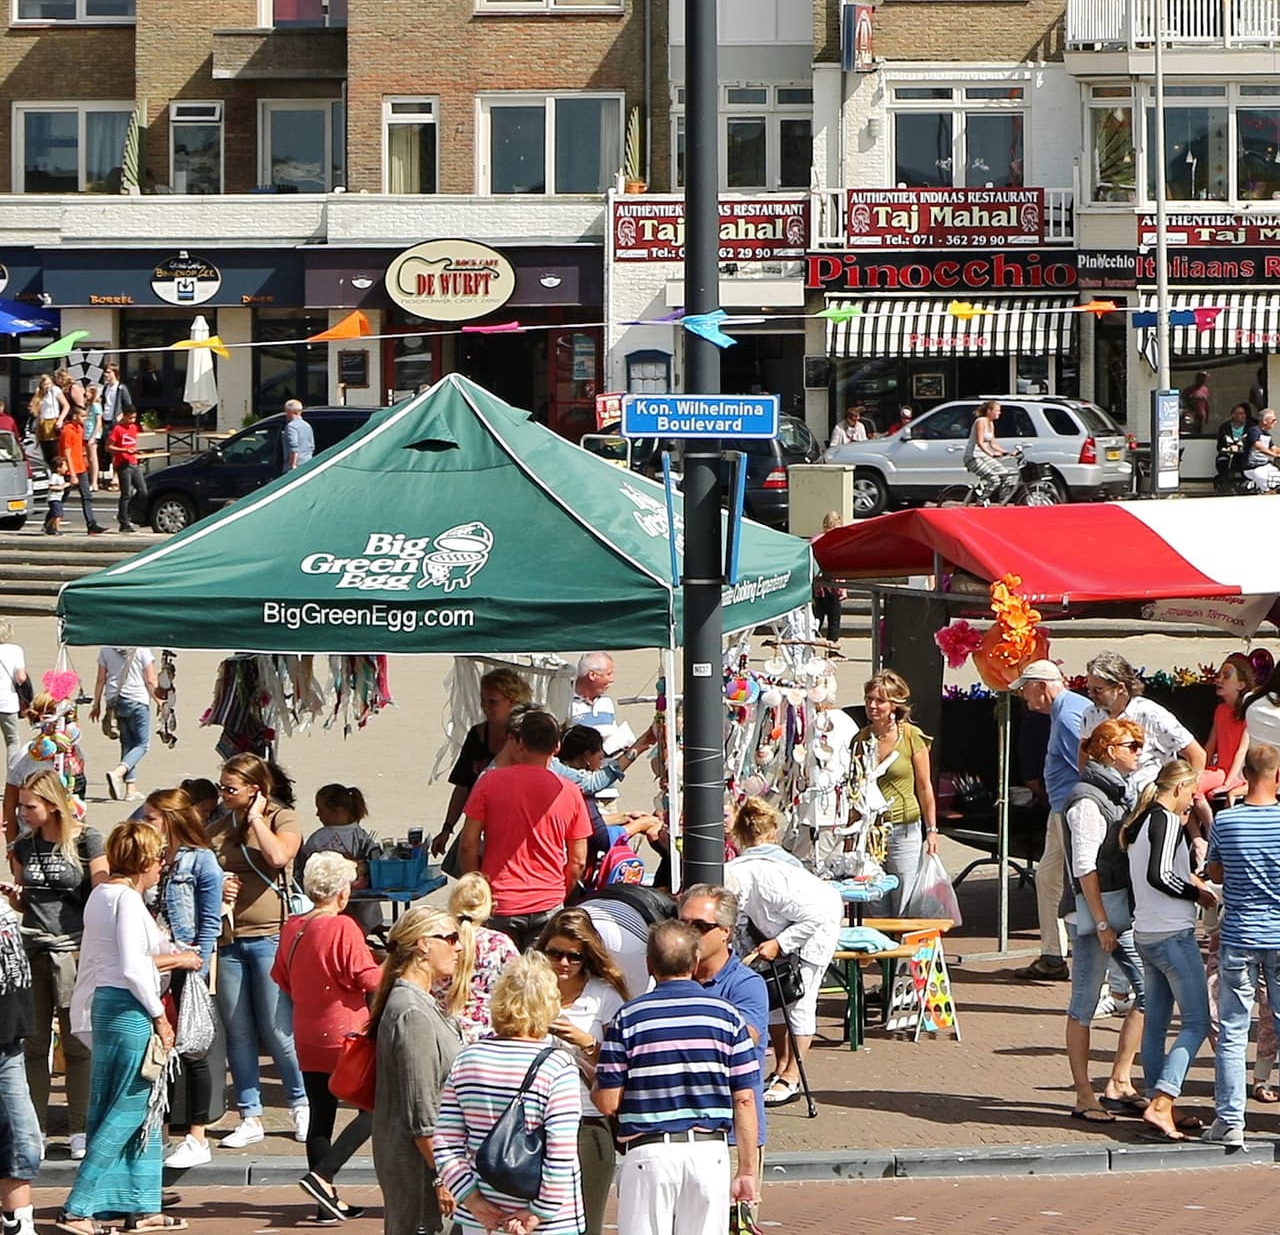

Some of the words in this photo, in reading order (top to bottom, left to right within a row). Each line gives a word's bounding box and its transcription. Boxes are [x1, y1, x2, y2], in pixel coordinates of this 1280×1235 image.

[850, 191, 917, 204] AUTHENTIEK
[919, 192, 965, 203] INDIAAS
[968, 191, 1039, 203] RESTAURANT
[616, 204, 684, 217] AUTHENTIEK
[733, 204, 805, 216] RESTAURANT
[873, 204, 918, 233] Taj
[929, 205, 1018, 228] Mahal
[639, 218, 686, 246] Taj
[718, 218, 783, 240] ahal
[913, 235, 934, 245] 071
[946, 235, 968, 245] 362
[972, 235, 987, 245] 29
[990, 235, 1005, 245] 90
[1195, 228, 1246, 243] Taj
[718, 248, 734, 258] 62
[738, 248, 752, 258] 29
[756, 249, 771, 258] 90
[1077, 254, 1135, 269] Pinocchio
[805, 253, 1077, 289] Pinocchio
[1136, 255, 1254, 278] Itliaans
[416, 273, 435, 296] DE
[439, 272, 493, 296] WURFT
[908, 333, 988, 349] Pinocchio
[636, 402, 672, 415] Kon.
[677, 401, 763, 416] Wilhelmina
[658, 416, 742, 431] Boulevard
[364, 534, 429, 559] Big
[301, 553, 419, 574] Green
[336, 572, 415, 591] Egg
[264, 603, 474, 631] BigGreenEgg.com
